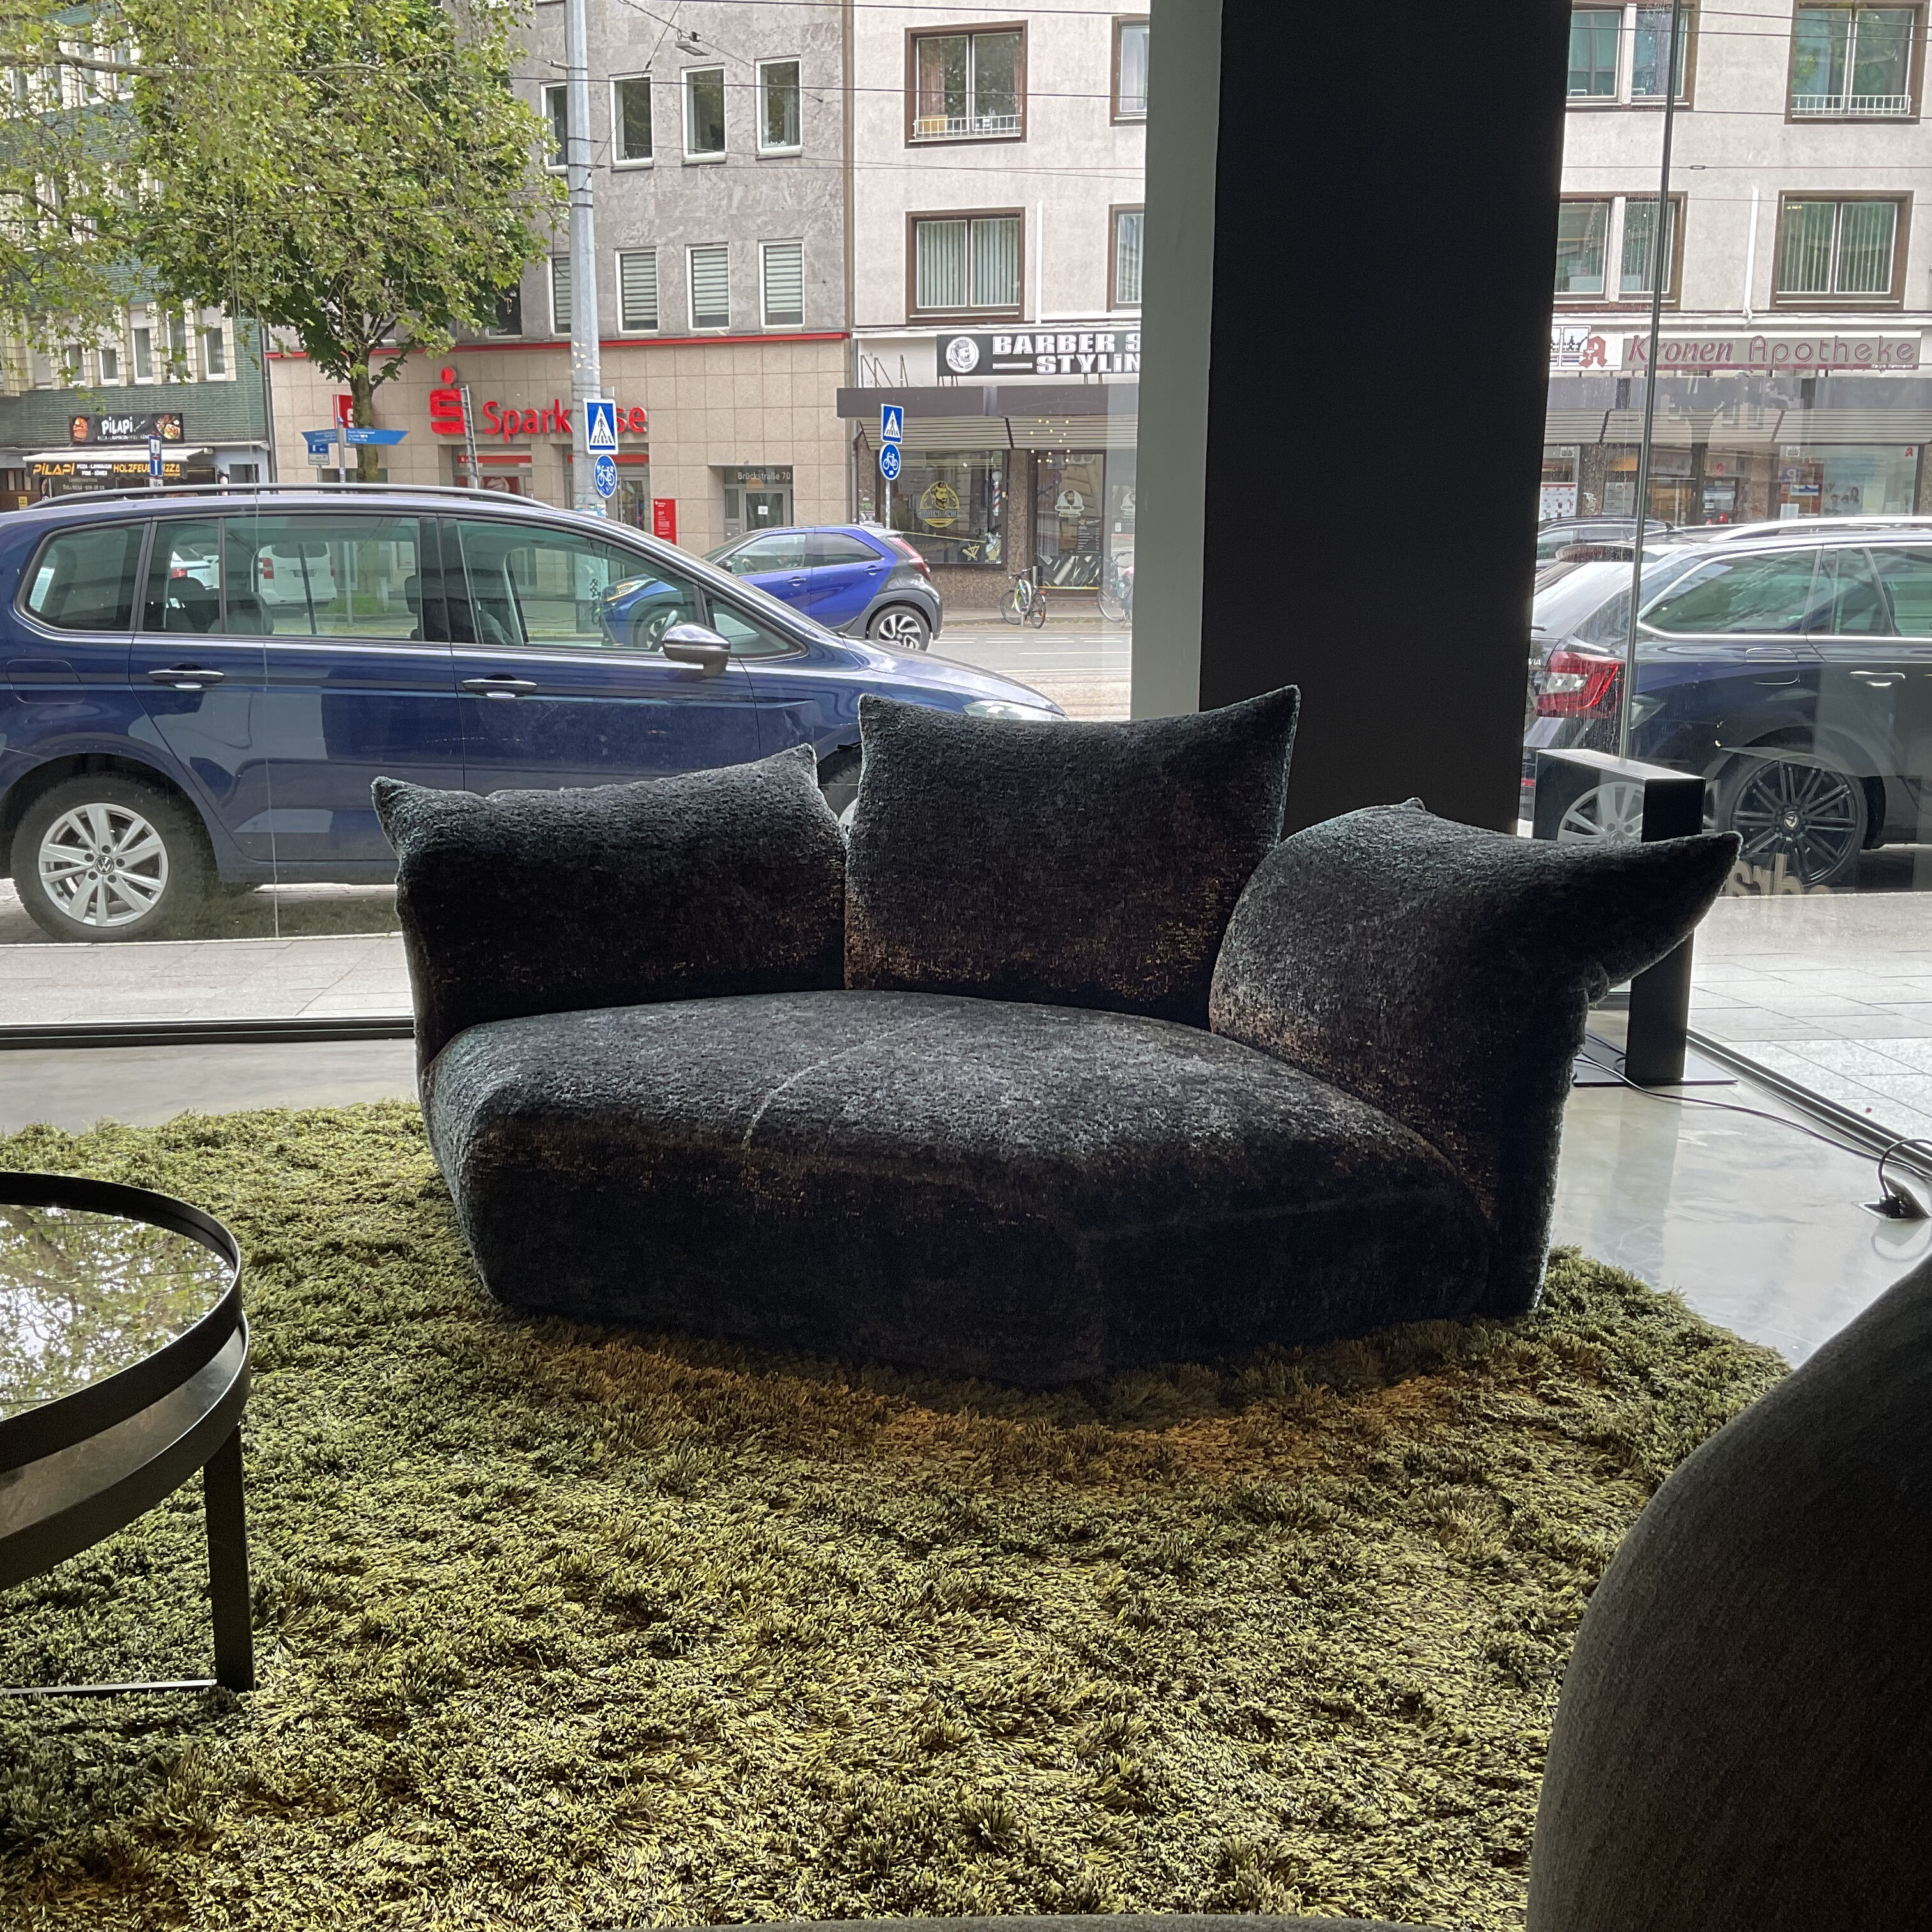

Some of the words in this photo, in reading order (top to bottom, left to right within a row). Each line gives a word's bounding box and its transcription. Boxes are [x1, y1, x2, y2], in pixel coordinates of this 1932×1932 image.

[992, 334, 1115, 355] BARBER
[1749, 335, 1915, 368] Apotheke
[483, 399, 647, 443] Sparkse
[113, 463, 150, 473] HOLZFEUE
[162, 463, 180, 473] IZZA
[737, 471, 780, 480] Brückstraße
[781, 471, 791, 480] 70
